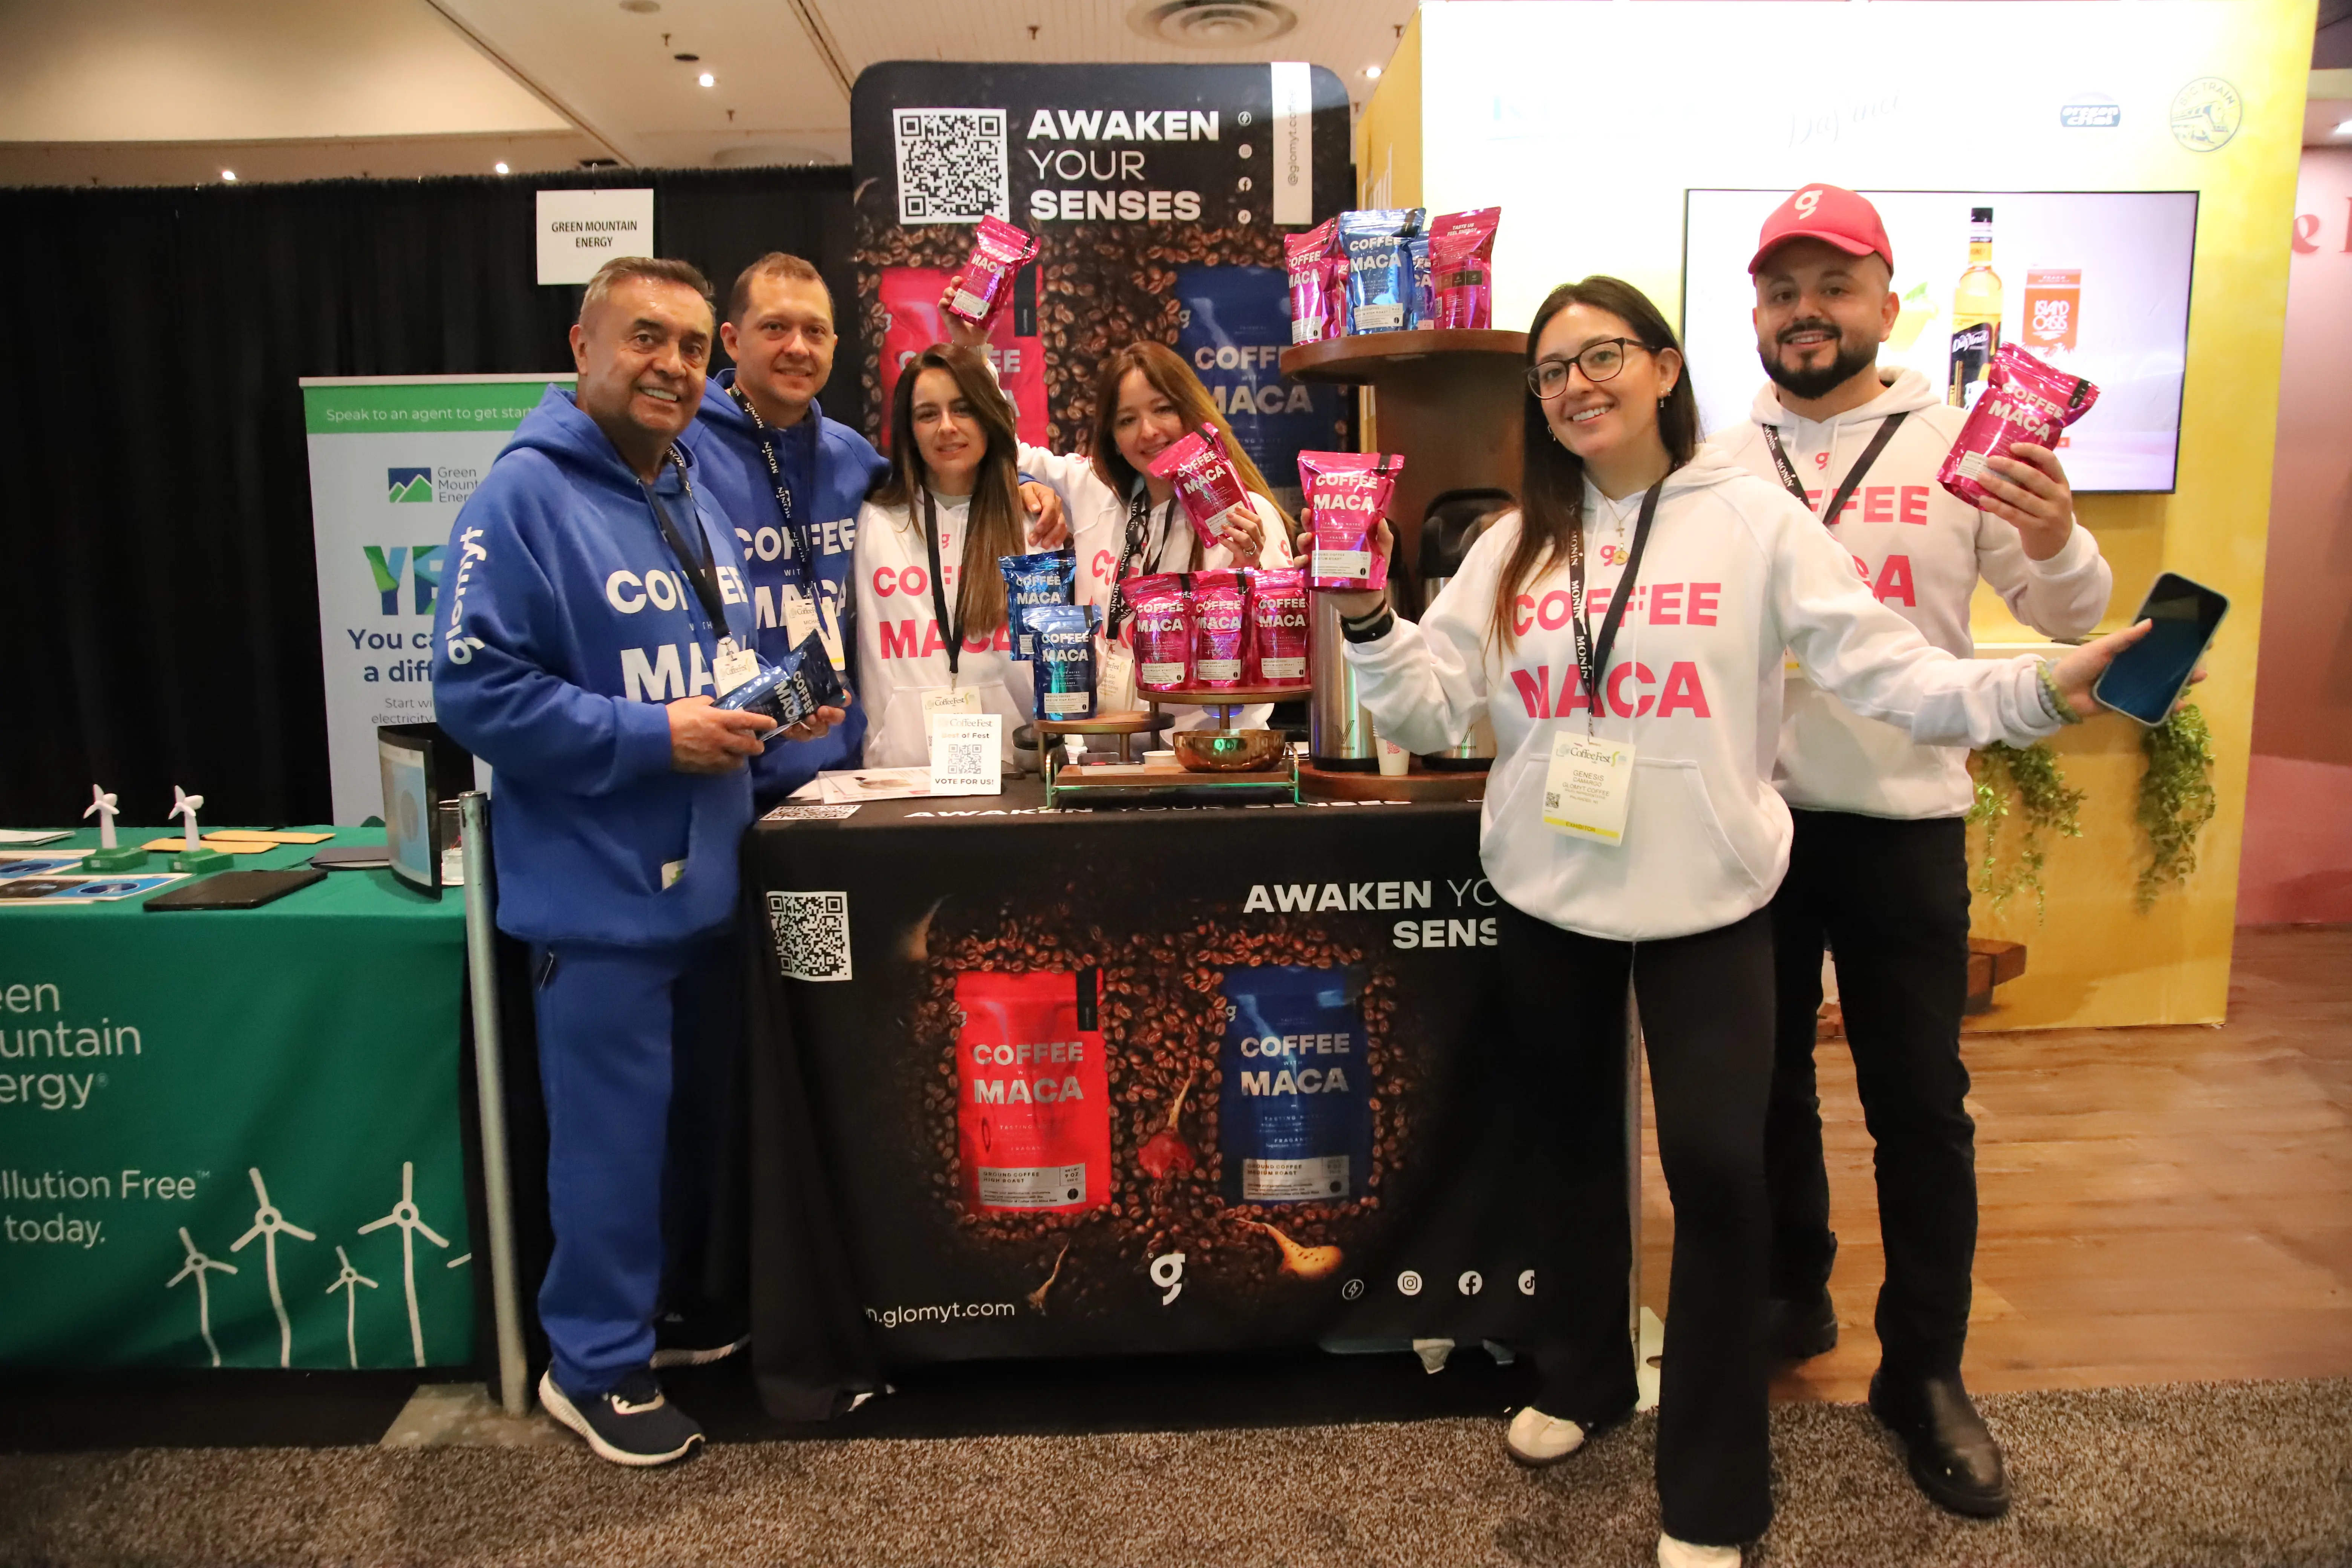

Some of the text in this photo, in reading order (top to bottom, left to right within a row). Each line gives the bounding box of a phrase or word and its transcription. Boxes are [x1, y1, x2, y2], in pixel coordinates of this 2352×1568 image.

[2202, 82, 2236, 105] TRAIN
[2062, 107, 2119, 117] oregon
[1027, 109, 1219, 141] AWAKEN
[1027, 149, 1145, 181] YOUR
[1030, 190, 1201, 221] SENSES
[1794, 190, 1823, 220] g
[551, 220, 637, 233] GREEN MOUNTAIN
[576, 236, 613, 248] ENERGY
[1349, 235, 1402, 251] COFFEE
[1288, 250, 1321, 268] COFFEE
[1350, 253, 1402, 273] MACA
[1289, 268, 1320, 289] MACA
[2035, 300, 2070, 315] ISLAND
[1952, 330, 1989, 353] DaVinci
[1195, 345, 1293, 371] COFF
[2002, 382, 2065, 420] COFFEE
[326, 408, 370, 423] Speak
[373, 410, 387, 420] to
[390, 411, 407, 420] an
[412, 409, 453, 422] agent
[456, 409, 471, 419] to
[475, 407, 498, 421] get
[1988, 400, 2050, 441] MACA
[763, 441, 779, 474] MONIN
[1177, 450, 1217, 478] COFFEE
[438, 466, 476, 478] Green
[1183, 464, 1227, 495] MACA
[1315, 474, 1378, 489] COFFEE
[1775, 458, 1796, 488] MONIN
[1313, 493, 1375, 513] MACA
[1119, 543, 1132, 573] MONIN
[1016, 575, 1061, 586] COFFEE
[446, 526, 487, 665] glomyt
[1017, 591, 1062, 605] MACA
[1110, 582, 1121, 614] MONIN
[1258, 598, 1306, 609] COFFEE
[1571, 580, 1582, 619] MONIN
[1136, 602, 1184, 614] COFFEE
[1196, 600, 1242, 613] COFFEE
[1512, 582, 1721, 637] COFFEE
[1137, 618, 1184, 632] MACA
[1191, 616, 1242, 629] MACA
[1258, 614, 1306, 628] MACA
[347, 628, 403, 650] You
[1041, 633, 1090, 644] COFFEE
[1042, 649, 1089, 662] MACA
[1576, 635, 1593, 679] MONIN
[364, 664, 379, 683] a
[385, 697, 415, 709] Start
[793, 671, 815, 714] COFFEE
[1573, 769, 1604, 782] GENESIS
[1573, 776, 1602, 787] CAMARGO
[1562, 782, 1610, 796] GLOMYT COFFEE
[903, 808, 1093, 818] AWAKEN
[1565, 821, 1596, 832] EXHIBITOR
[1243, 880, 1432, 913] AWAKEN
[973, 1042, 1084, 1066] COFFEE
[1241, 1033, 1350, 1058] COFFEE
[974, 1076, 1084, 1105] MACA
[1241, 1067, 1349, 1096] MACA
[2, 1170, 110, 1199] llution
[5, 1212, 106, 1250] today.
